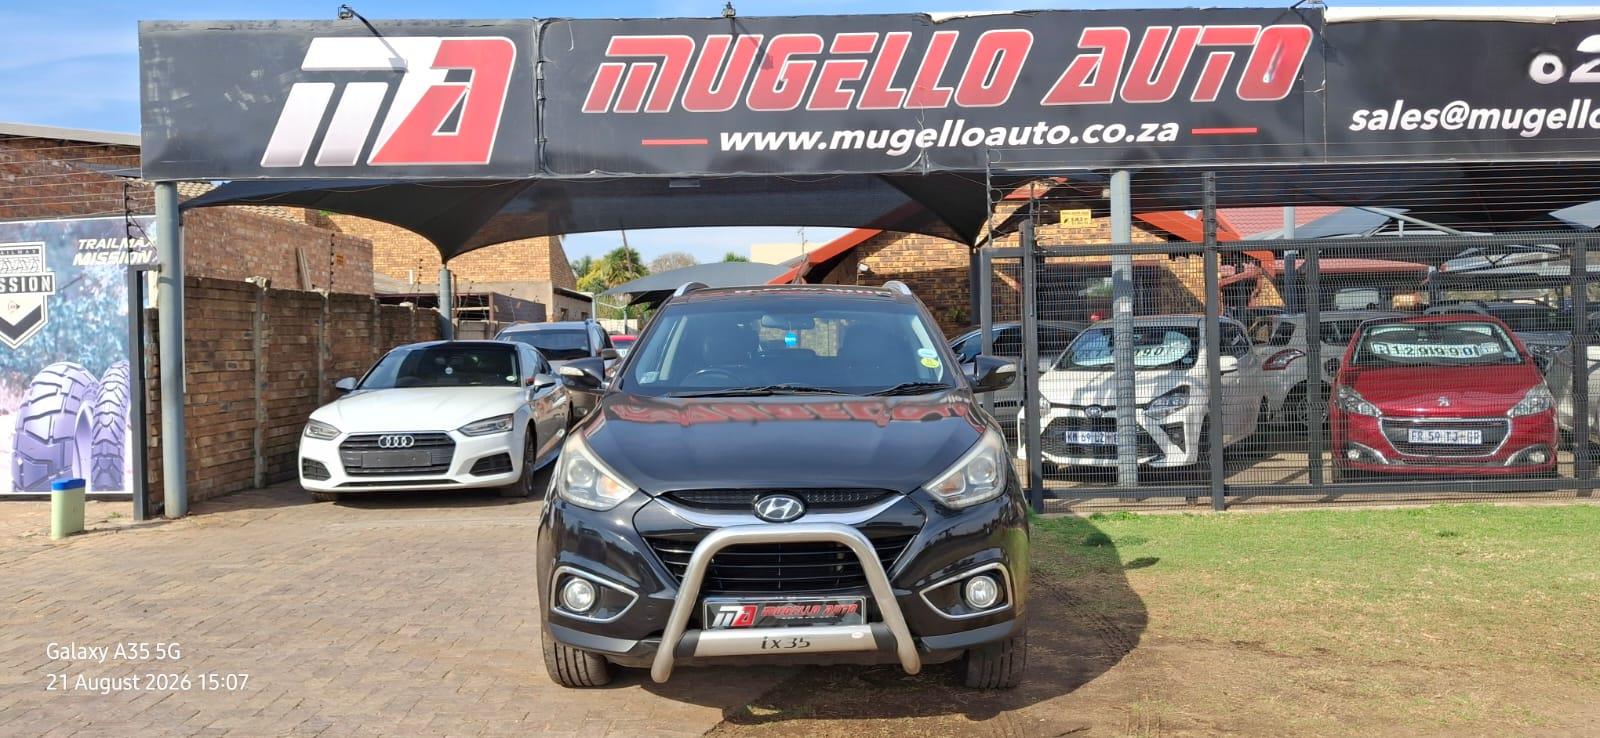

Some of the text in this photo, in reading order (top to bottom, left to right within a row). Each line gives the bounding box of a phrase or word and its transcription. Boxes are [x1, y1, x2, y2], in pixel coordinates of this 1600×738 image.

[581, 24, 1313, 114] MUGELLO AUTO
[720, 121, 1179, 157] www.mugelloauto.co.za
[73, 251, 152, 265] MISSION
